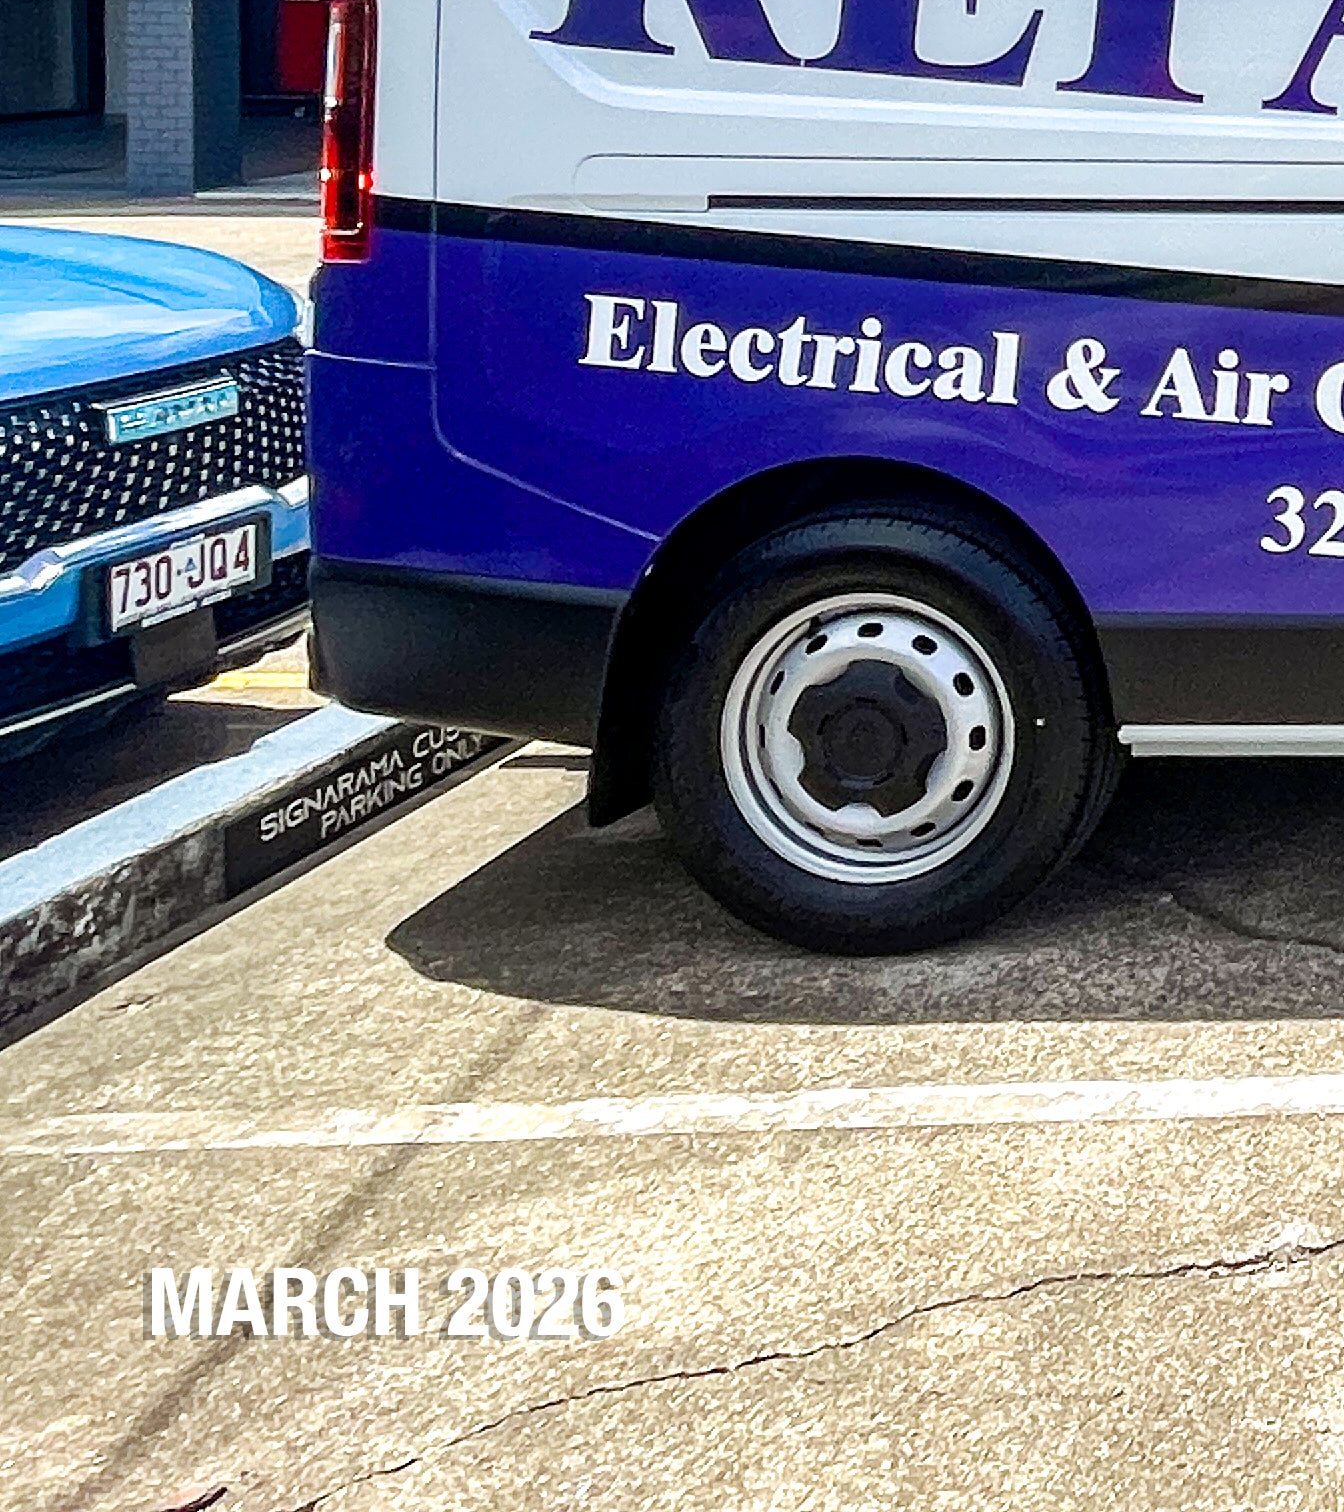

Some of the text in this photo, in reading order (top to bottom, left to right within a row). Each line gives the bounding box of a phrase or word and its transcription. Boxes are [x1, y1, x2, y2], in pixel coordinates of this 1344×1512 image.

[577, 293, 1021, 406] Electrical
[1046, 336, 1121, 413] &
[1139, 347, 1291, 427] Air
[259, 749, 405, 842] SIGNARAMA
[320, 733, 483, 839] PARKING ONLY
